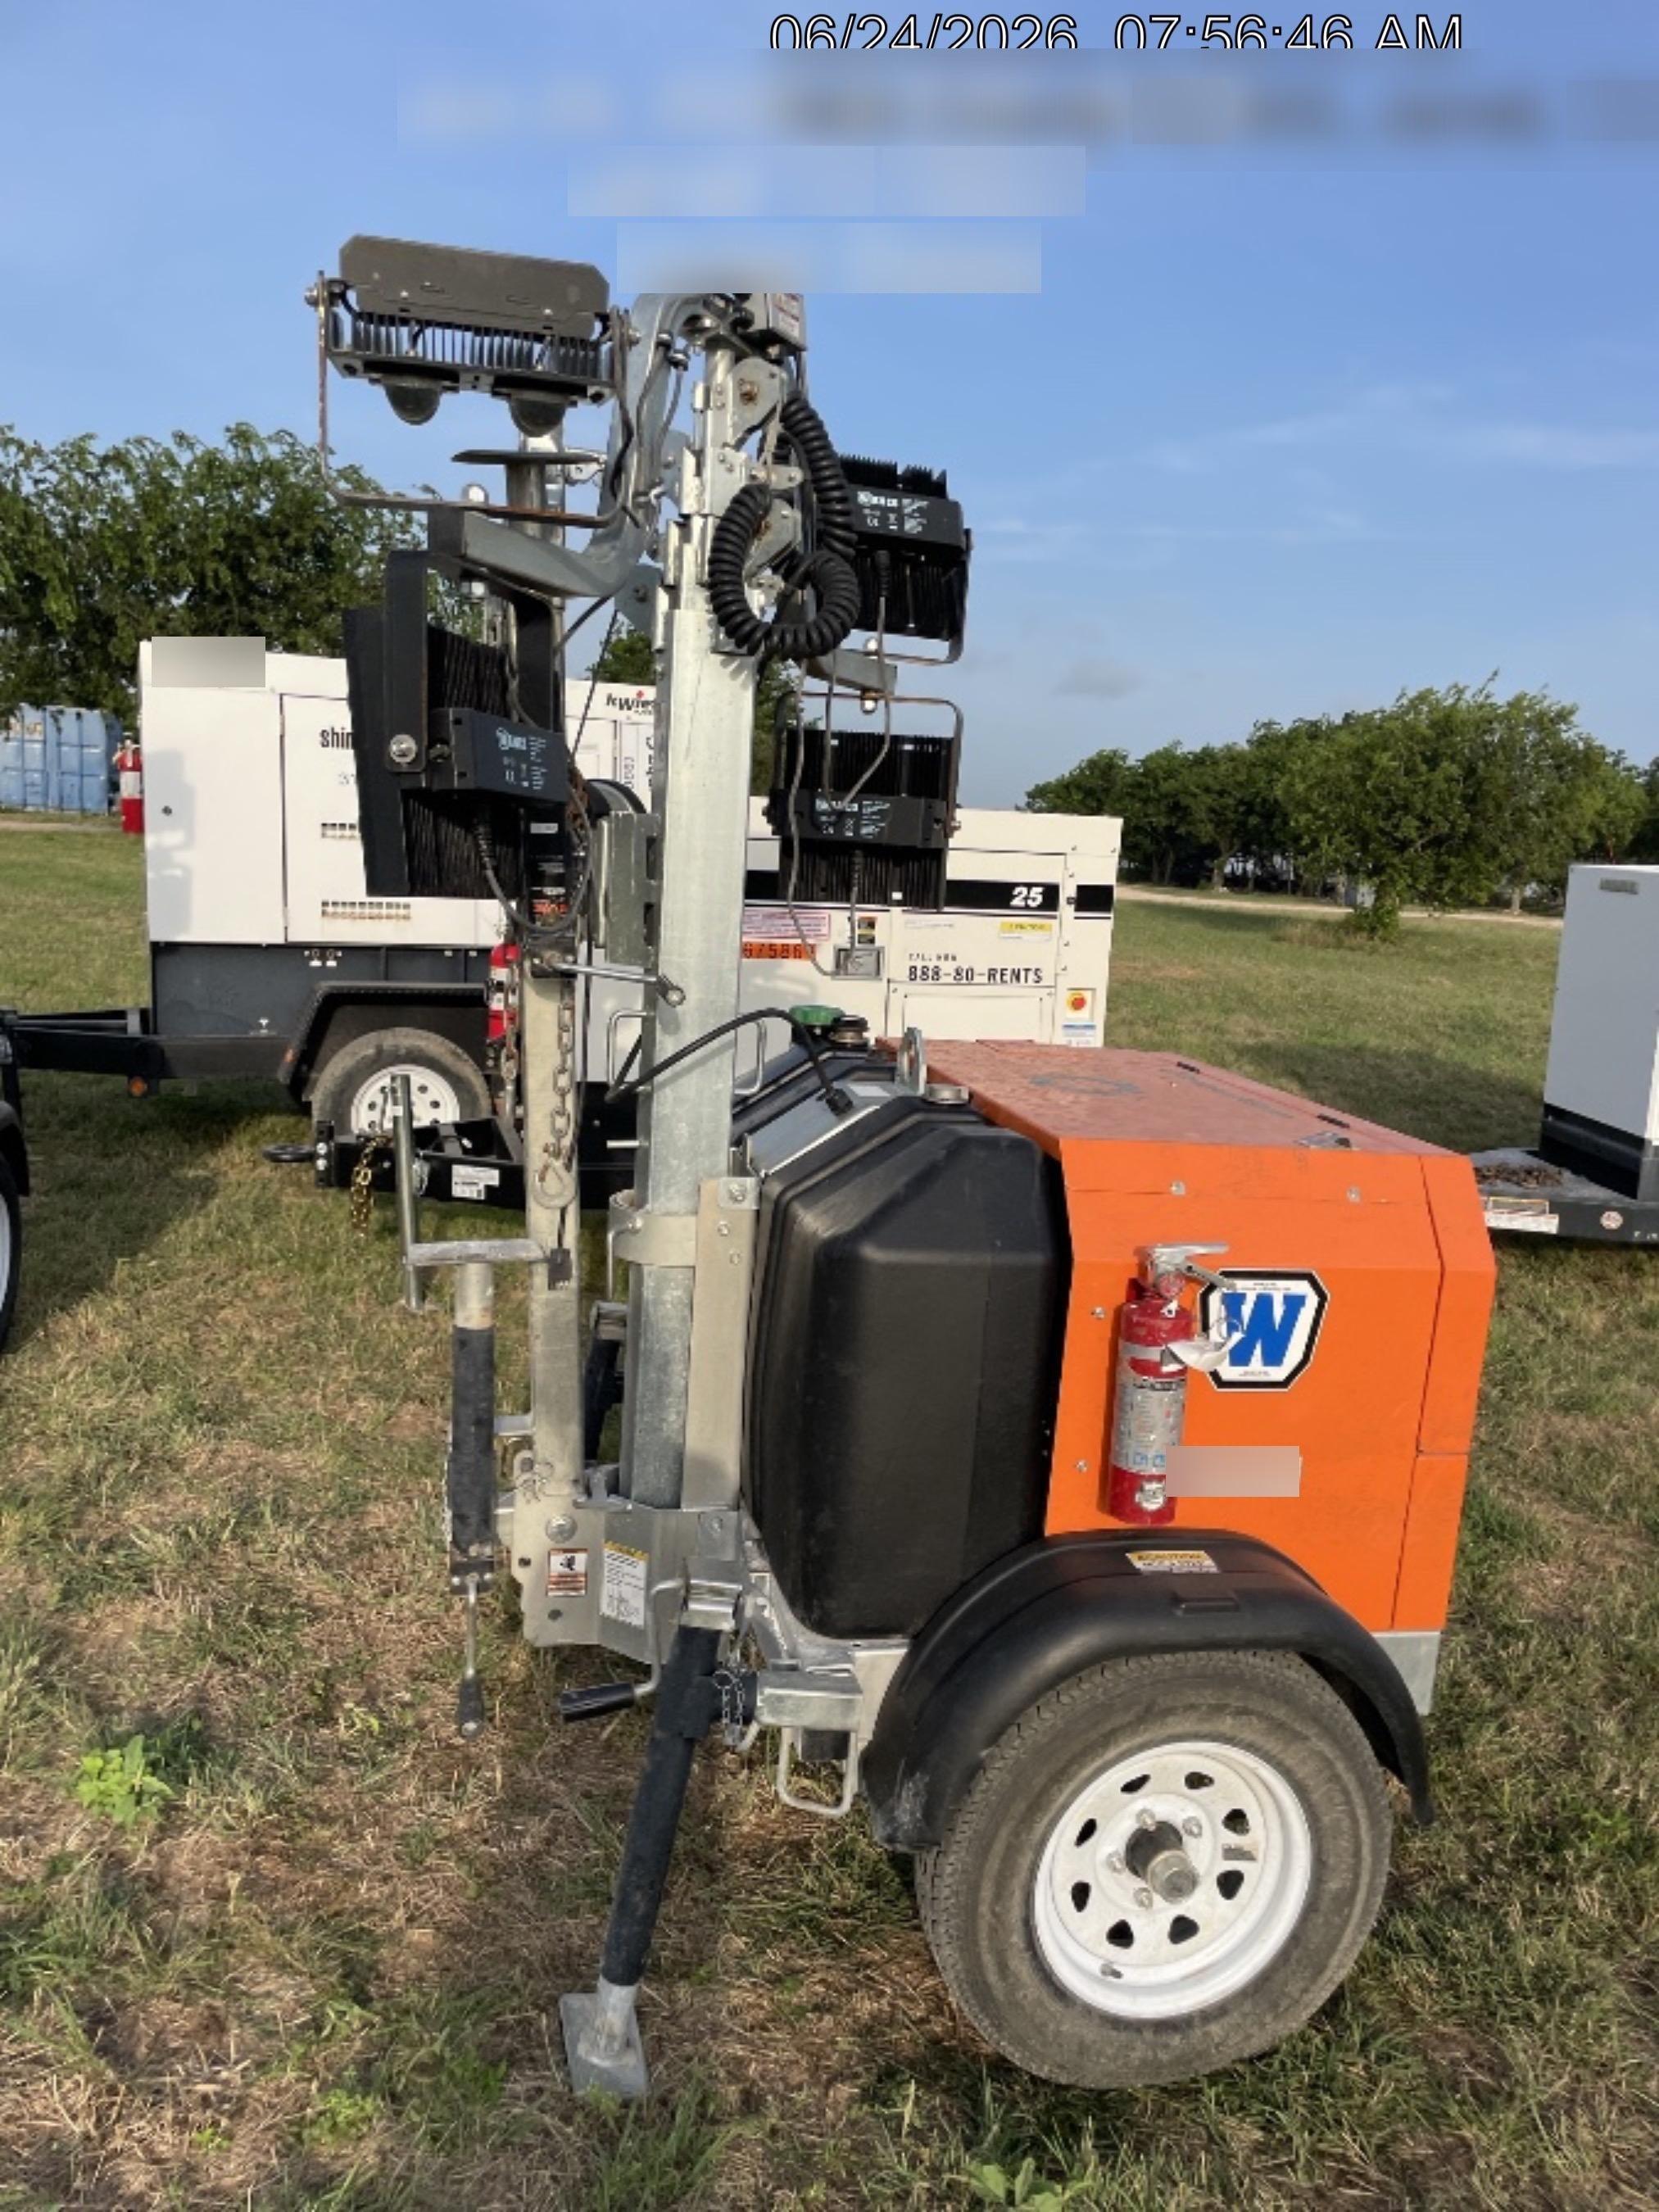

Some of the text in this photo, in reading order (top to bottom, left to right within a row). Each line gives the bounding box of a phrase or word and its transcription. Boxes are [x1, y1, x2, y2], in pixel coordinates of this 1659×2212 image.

[1009, 886, 1045, 909] 25
[908, 965, 1044, 984] 888-80-RENTS
[1222, 1292, 1307, 1367] W
